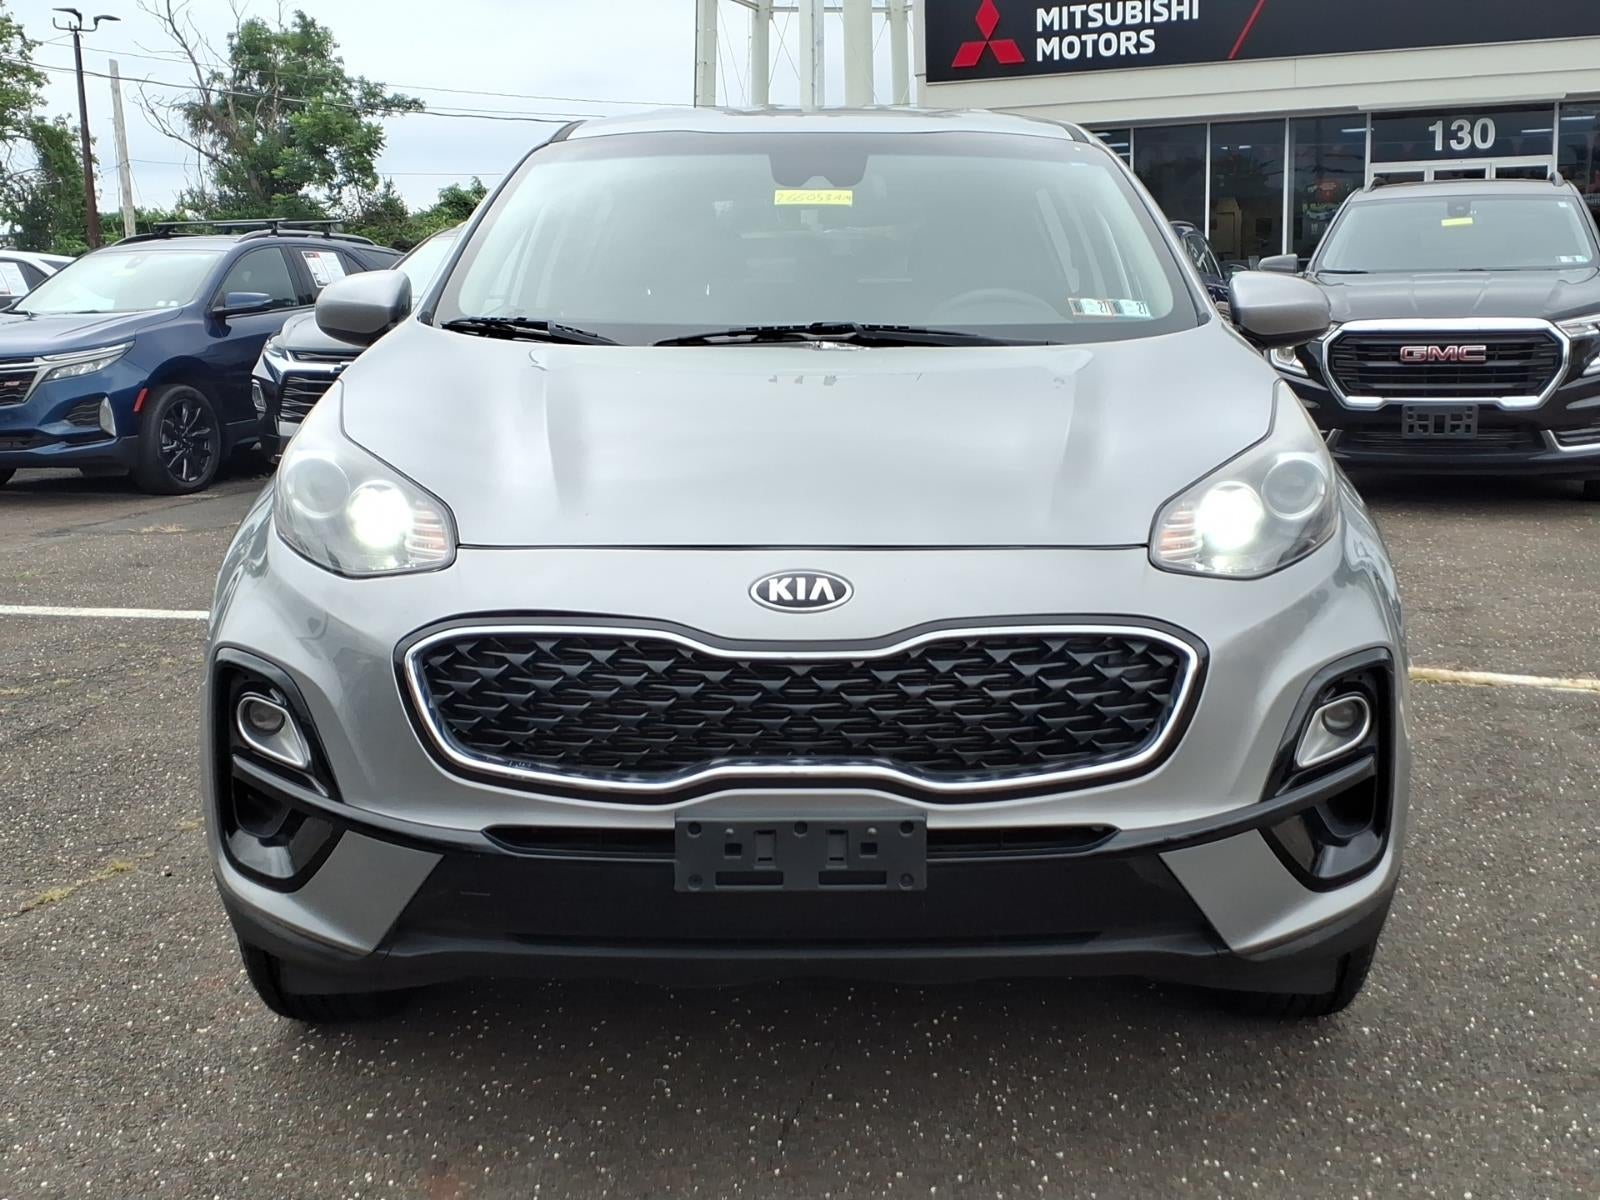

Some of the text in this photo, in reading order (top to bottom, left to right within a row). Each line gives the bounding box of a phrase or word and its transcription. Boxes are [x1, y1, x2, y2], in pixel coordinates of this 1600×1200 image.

[1036, 0, 1199, 32] MITSUBISHI
[1036, 29, 1156, 62] MOTORS
[1428, 117, 1496, 151] 130
[1400, 345, 1487, 361] GMC
[768, 577, 836, 601] KIA
